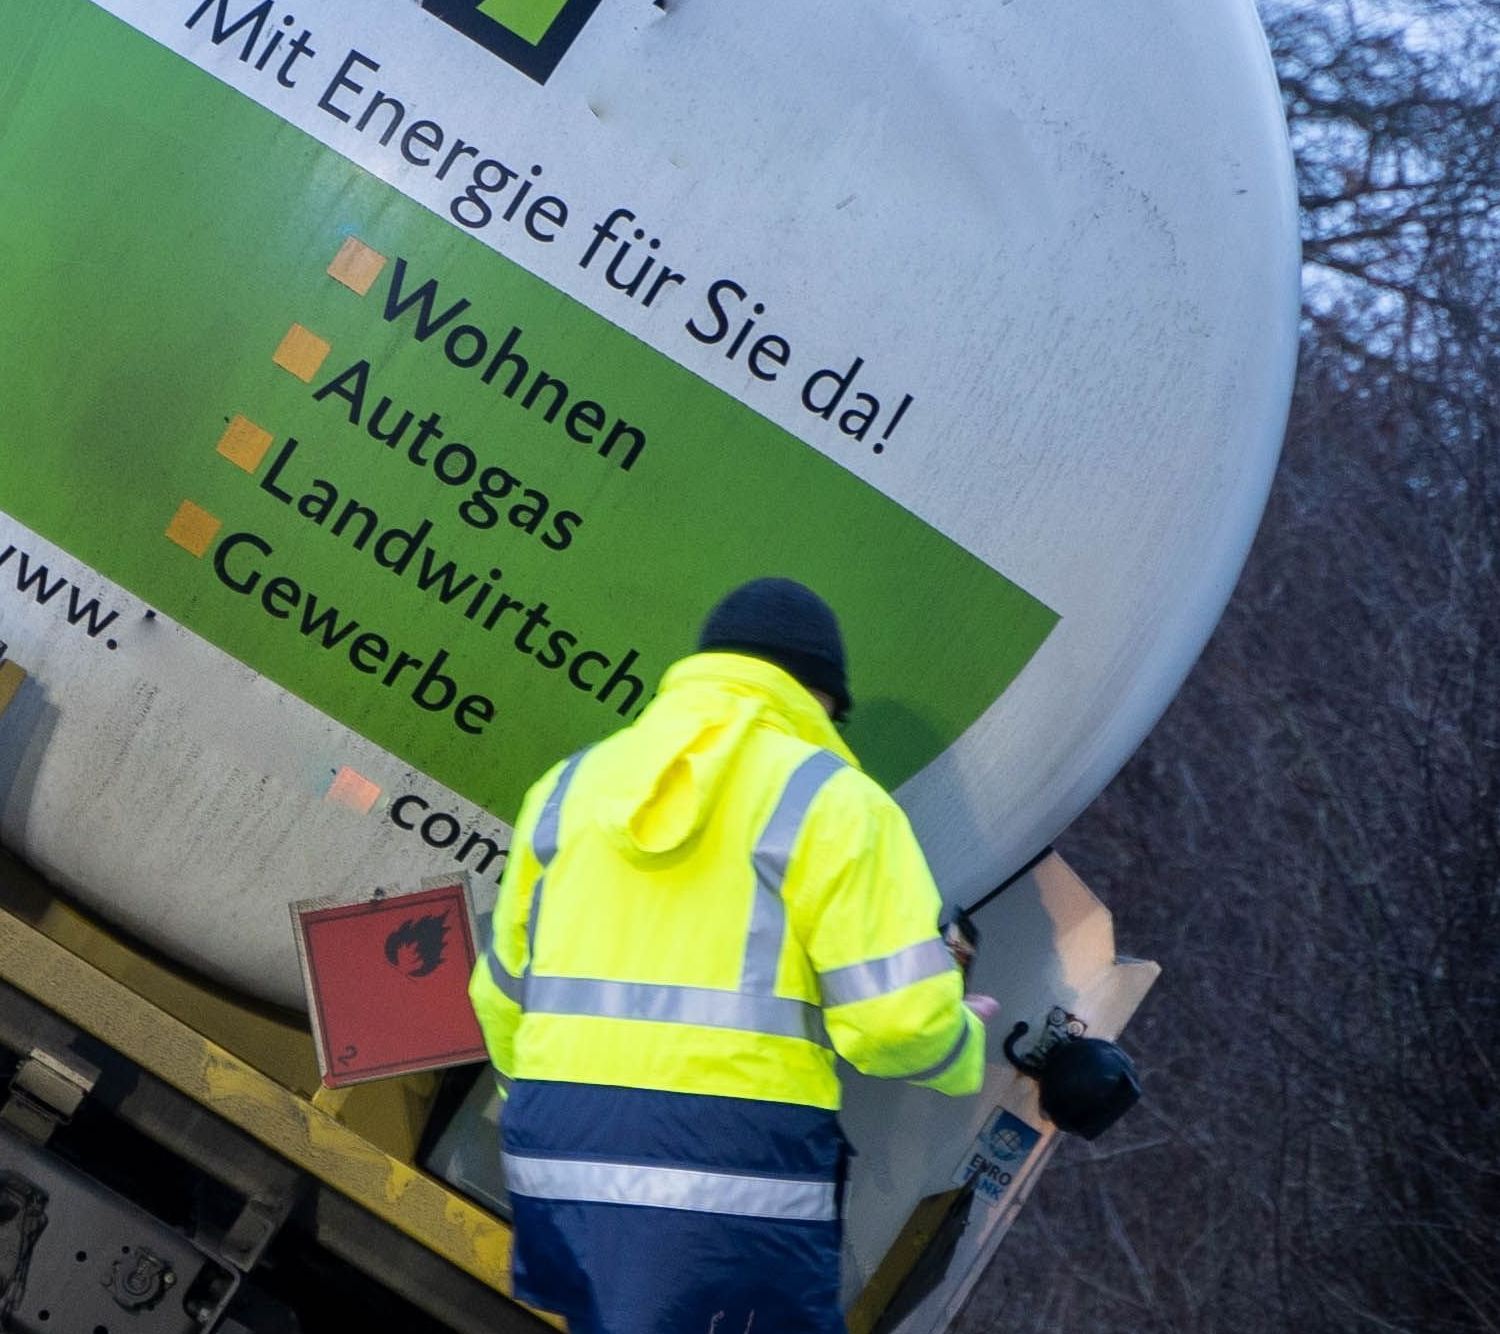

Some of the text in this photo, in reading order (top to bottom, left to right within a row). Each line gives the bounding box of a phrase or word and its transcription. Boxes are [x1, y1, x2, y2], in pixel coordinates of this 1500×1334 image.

[316, 49, 570, 243] Energie
[578, 207, 687, 309] für
[685, 278, 793, 383] Sie
[800, 357, 915, 456] da!
[311, 359, 584, 552] Autogas
[381, 257, 648, 473] Wohnen
[213, 531, 495, 736] Gewerbe
[258, 437, 656, 721] Landwirtsch
[338, 1045, 359, 1067] 2
